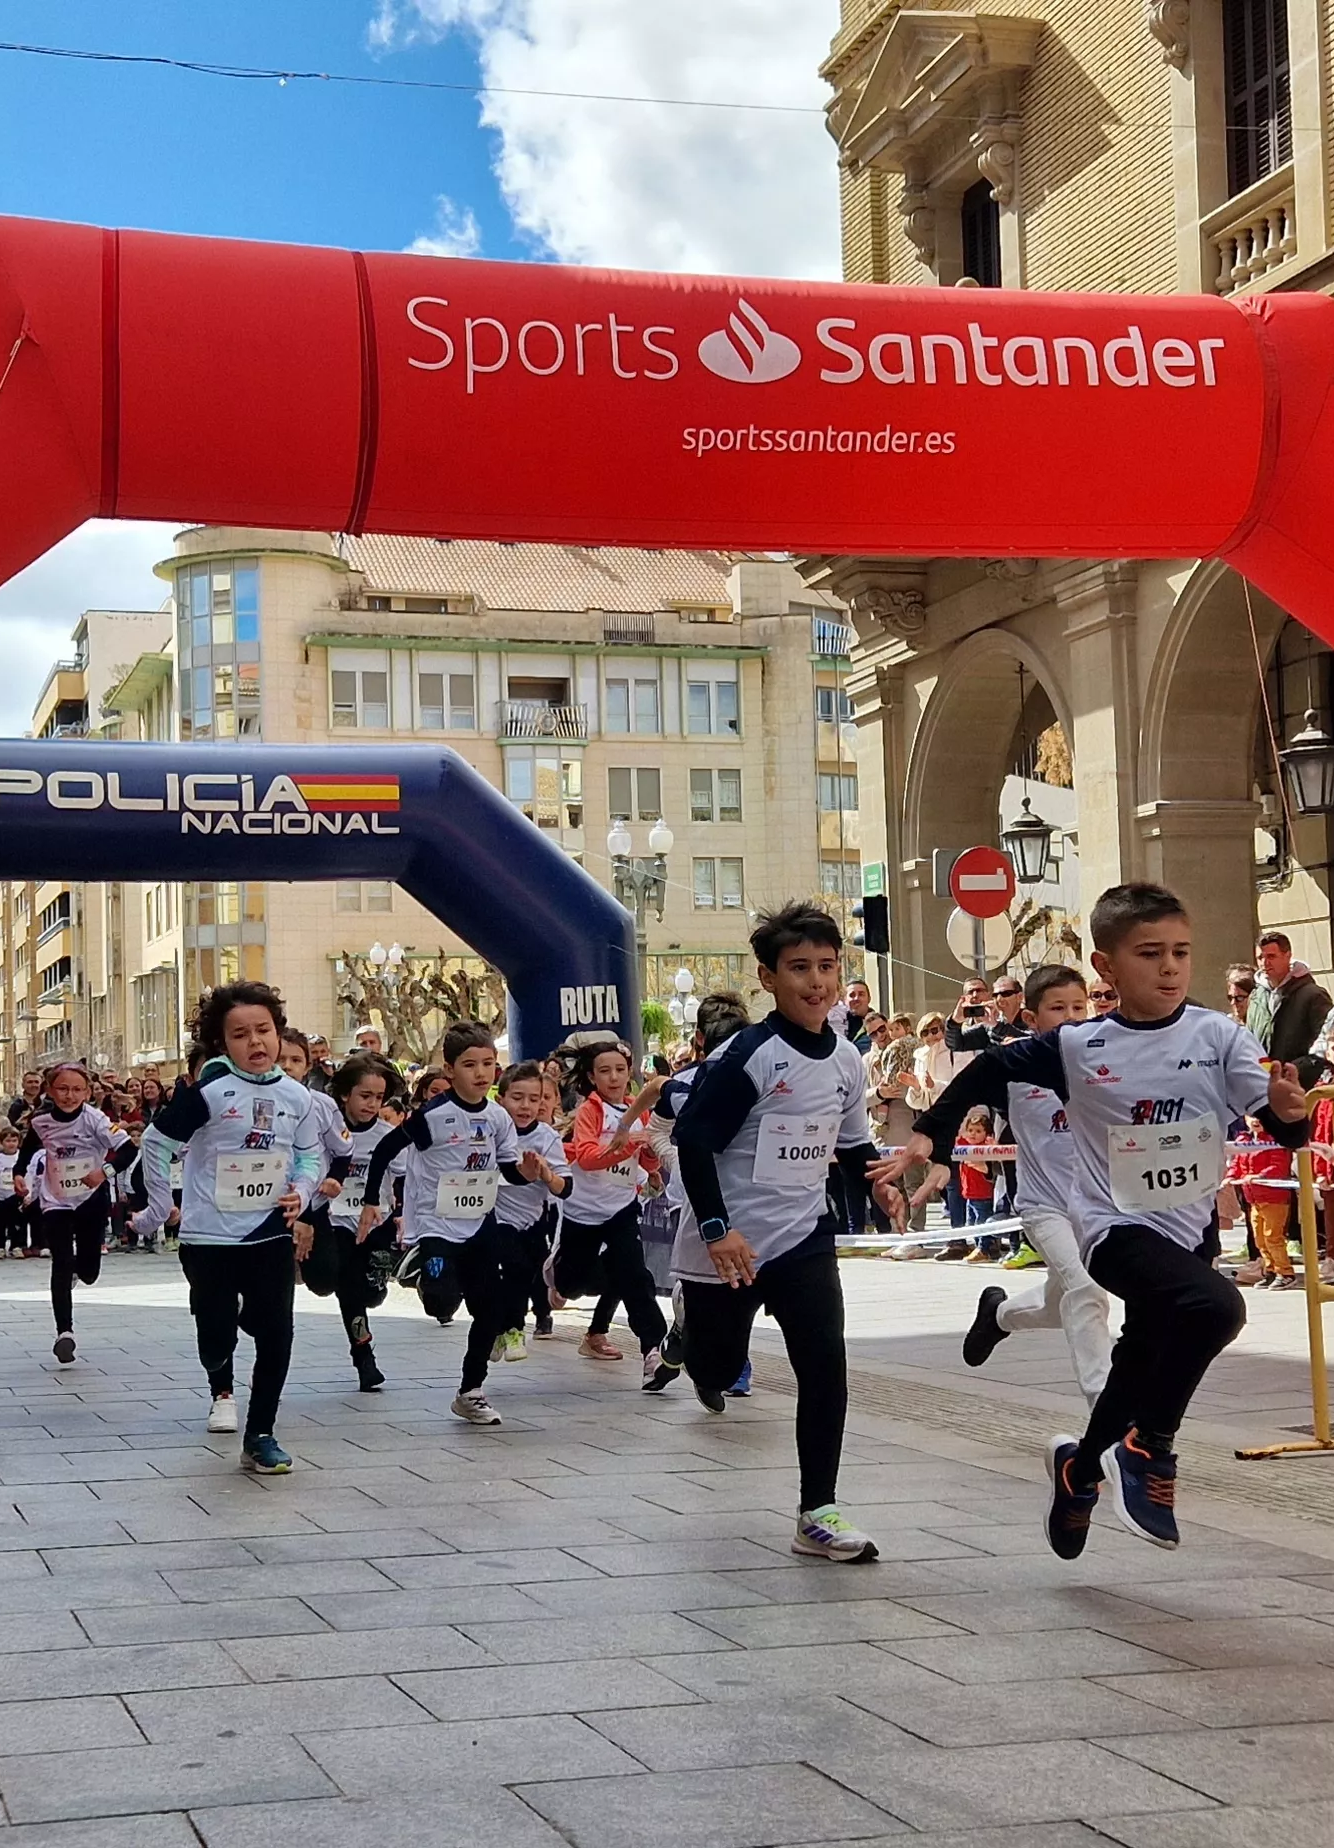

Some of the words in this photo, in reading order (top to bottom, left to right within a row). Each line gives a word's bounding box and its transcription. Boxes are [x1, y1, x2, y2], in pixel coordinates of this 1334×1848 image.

[406, 296, 679, 393] Sports
[816, 317, 1224, 387] Santander
[682, 423, 956, 458] sportssantander.es
[181, 812, 400, 834] NACIONAL
[560, 984, 620, 1026] RUTA
[777, 1144, 828, 1161] 10005
[1141, 1162, 1199, 1190] 1031
[237, 1182, 274, 1198] 1007
[453, 1195, 485, 1208] 1005
